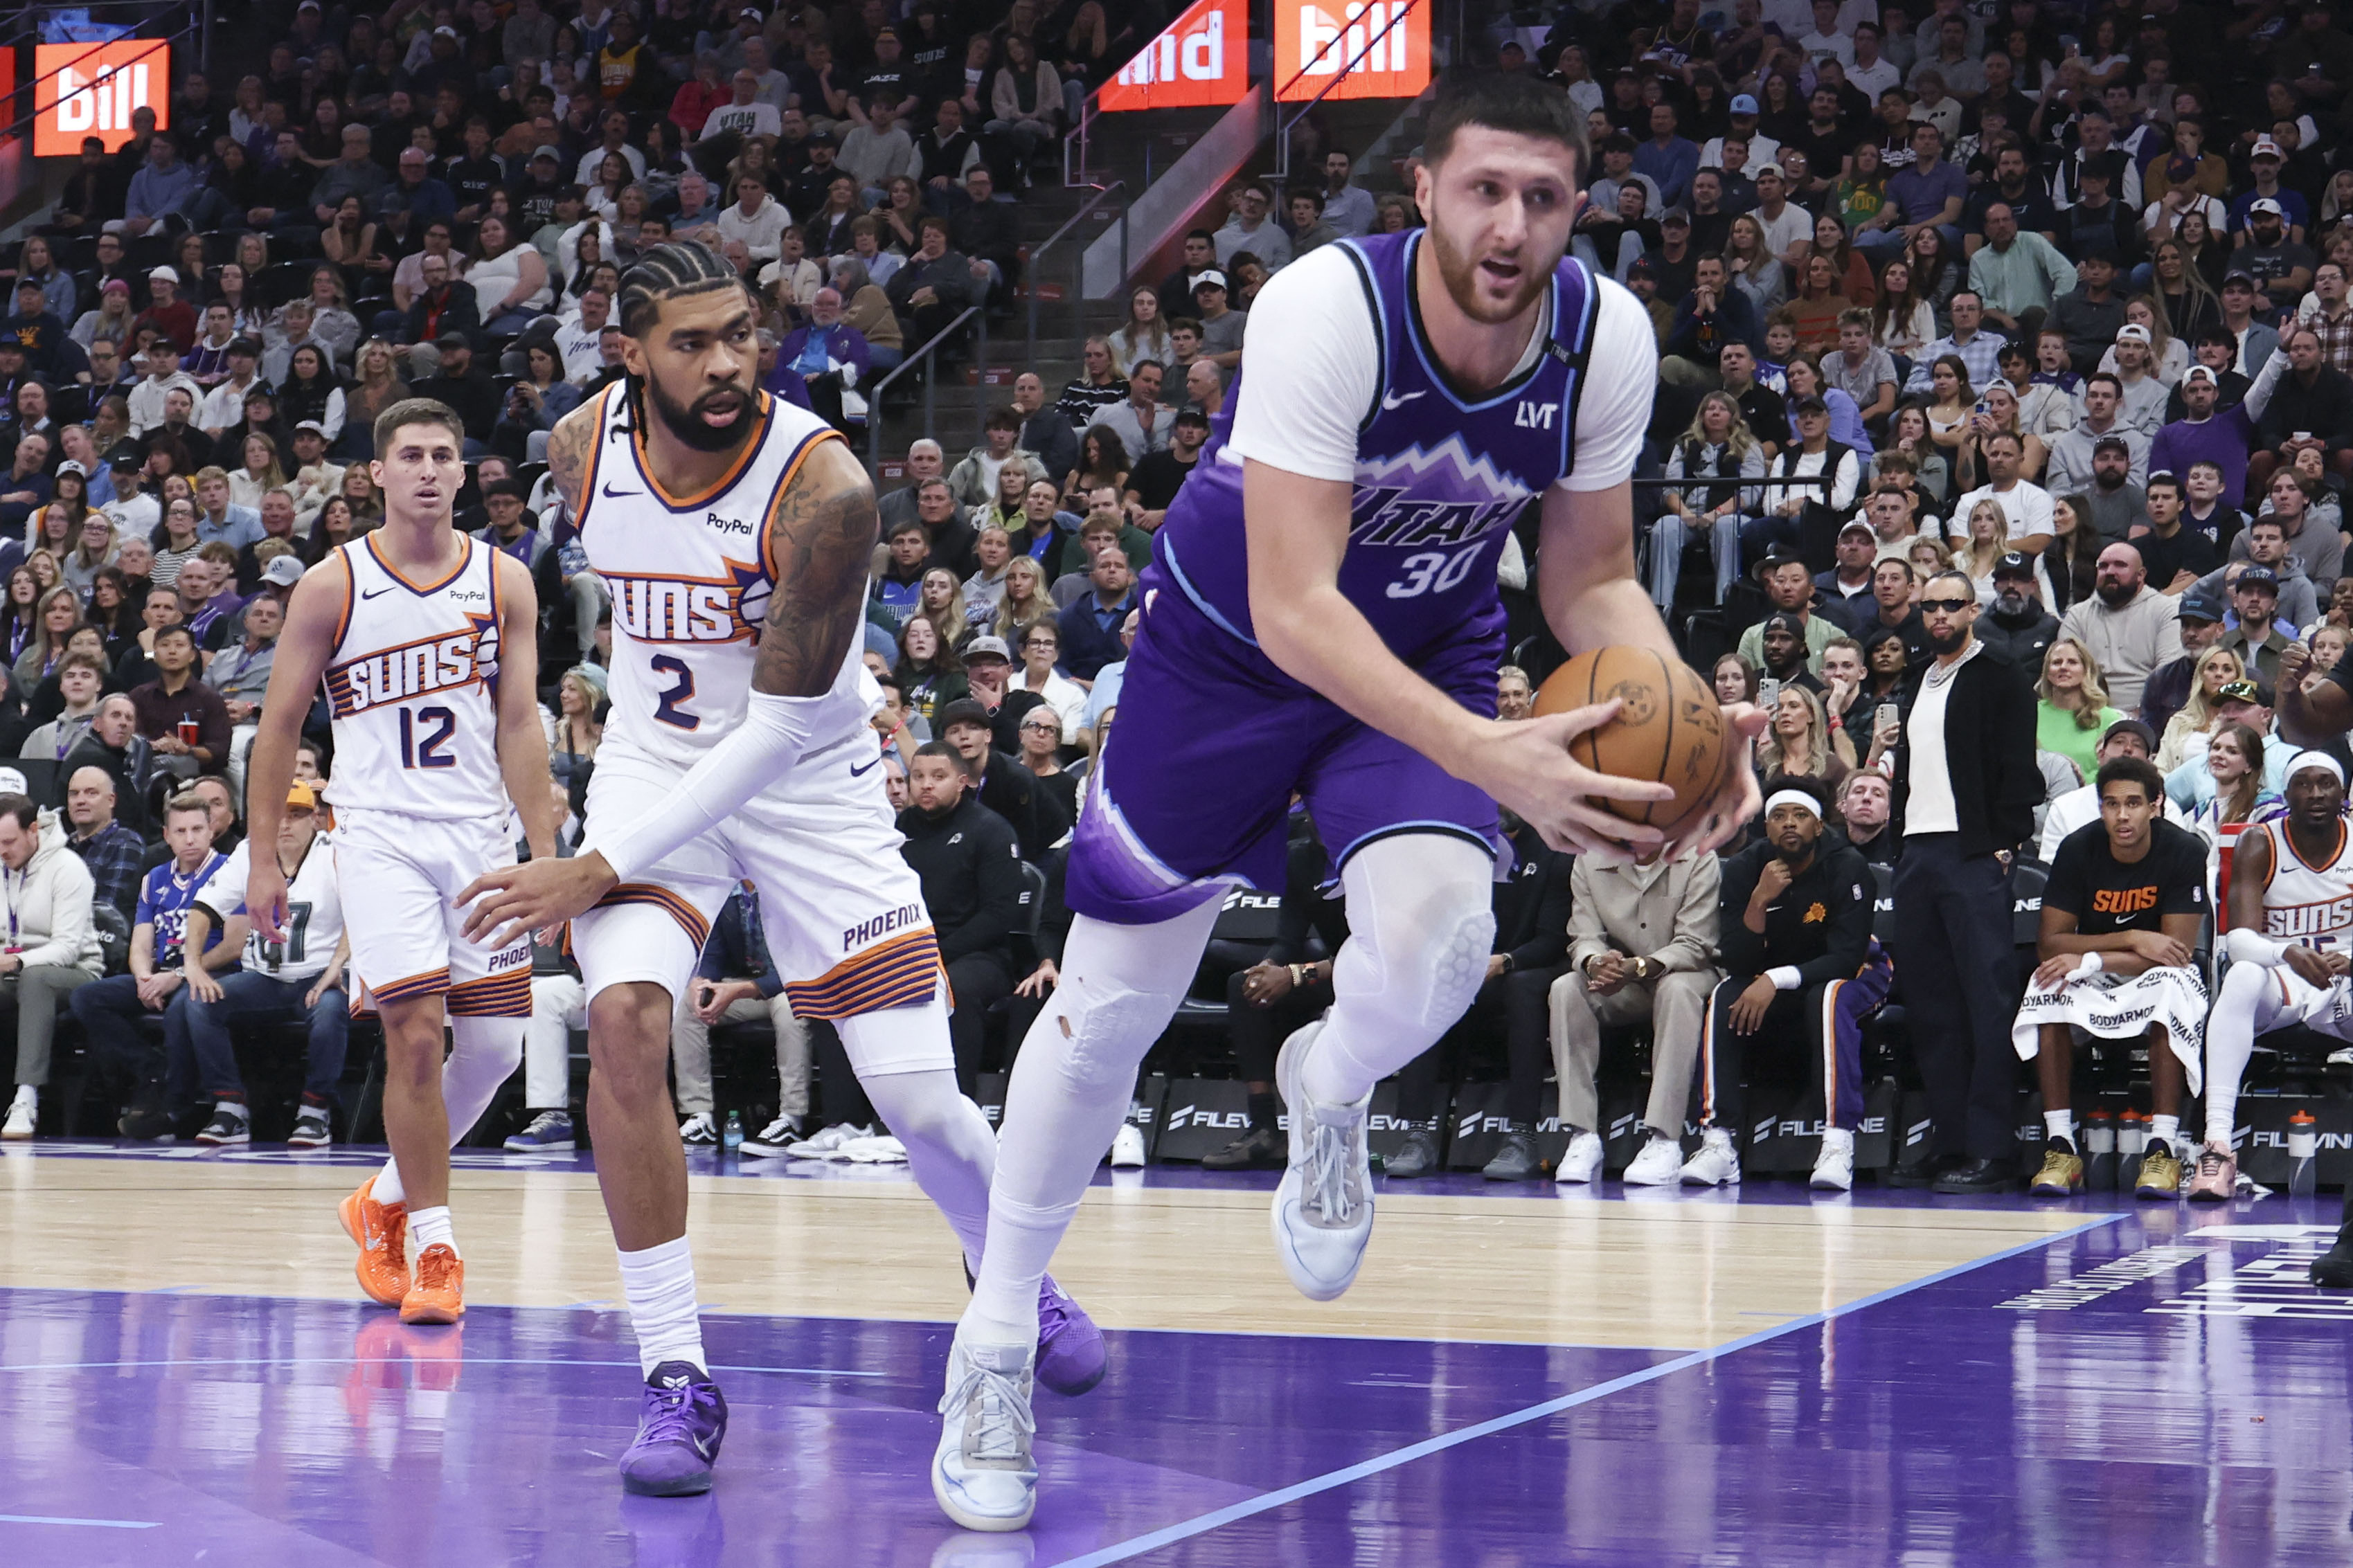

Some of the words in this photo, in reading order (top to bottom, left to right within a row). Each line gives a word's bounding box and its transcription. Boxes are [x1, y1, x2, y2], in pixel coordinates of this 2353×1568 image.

[1300, 1, 1406, 75] bill
[57, 64, 148, 132] bill
[720, 111, 755, 130] UTAH
[1514, 400, 1559, 429] LVT
[707, 513, 753, 535] PayPal
[1386, 541, 1487, 598] 30
[450, 591, 486, 602] PayPal
[611, 579, 735, 640] UNS
[348, 636, 474, 711] SUNS
[650, 653, 701, 732] 2
[400, 706, 456, 768] 12
[2336, 866, 2353, 875] PayP
[1240, 896, 1280, 908] FILE
[2093, 885, 2158, 913] SUNS
[2268, 898, 2353, 936] SUNS
[843, 903, 921, 953] PHOENIX
[488, 946, 529, 972] PHOE
